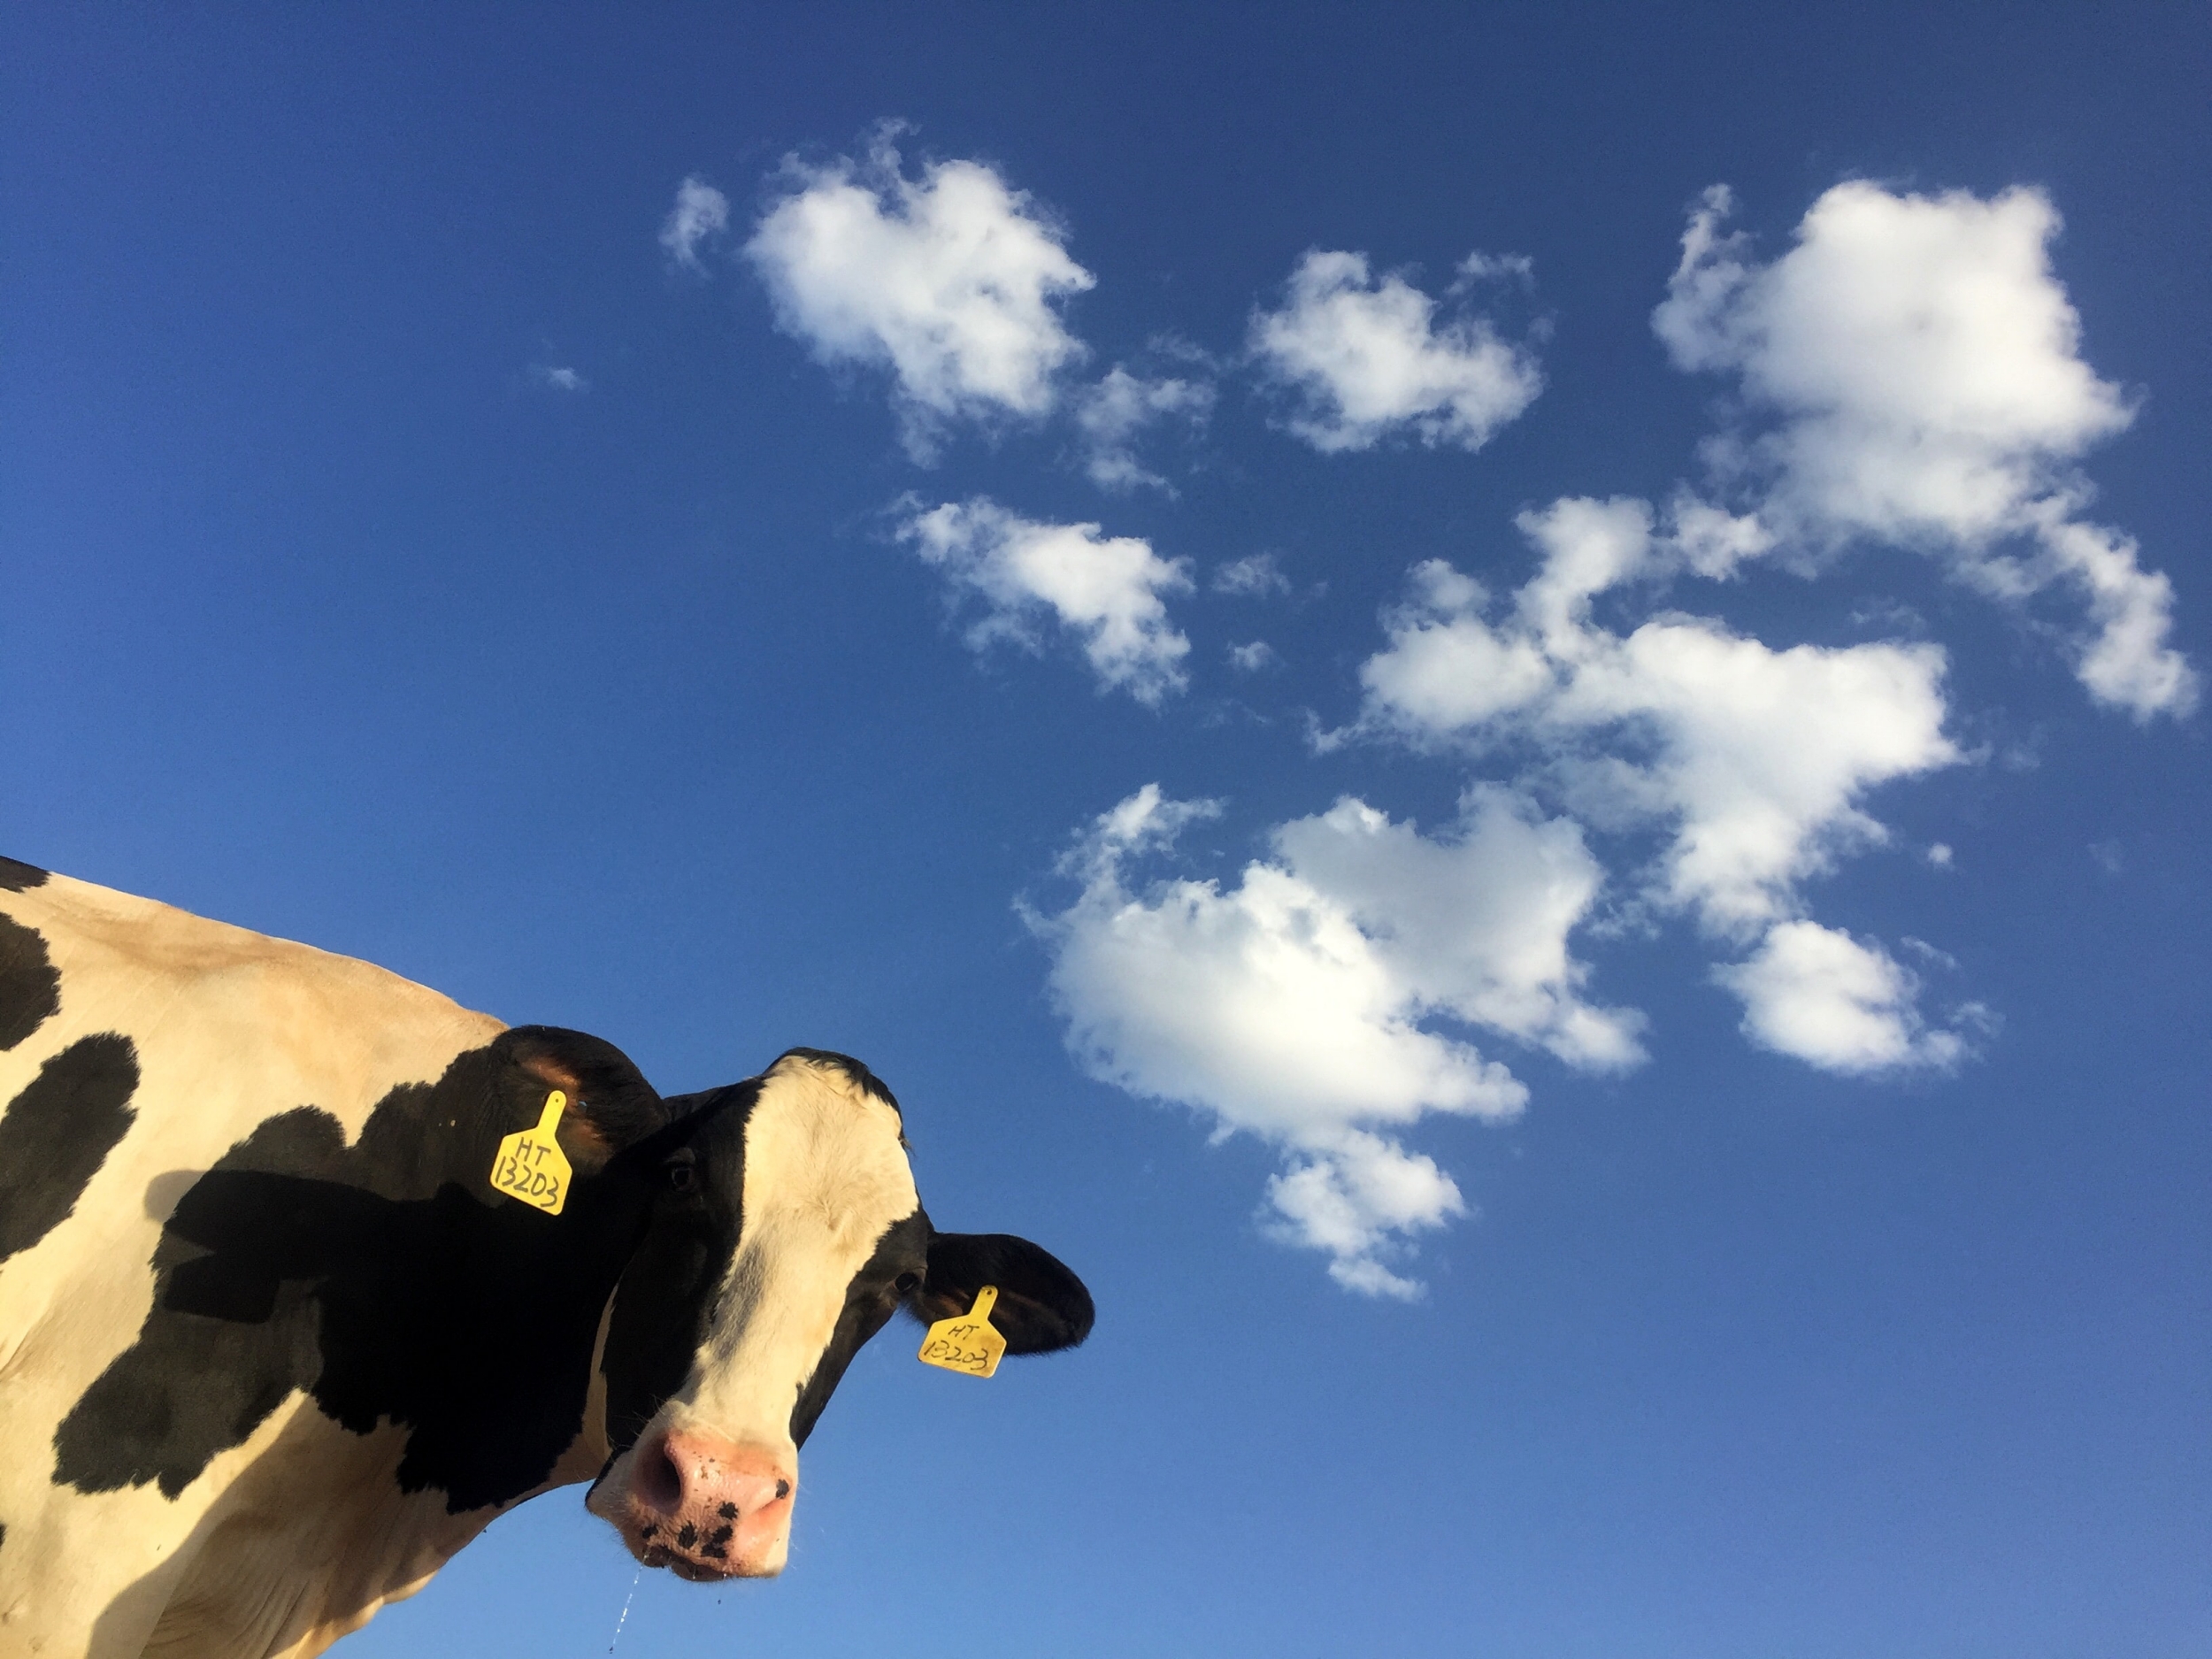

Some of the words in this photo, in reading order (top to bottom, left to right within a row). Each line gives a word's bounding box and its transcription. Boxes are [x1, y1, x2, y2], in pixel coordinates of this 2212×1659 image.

[516, 1137, 551, 1166] HT
[495, 1156, 559, 1208] 13203
[948, 1325, 979, 1340] HT
[924, 1340, 988, 1370] 13203
